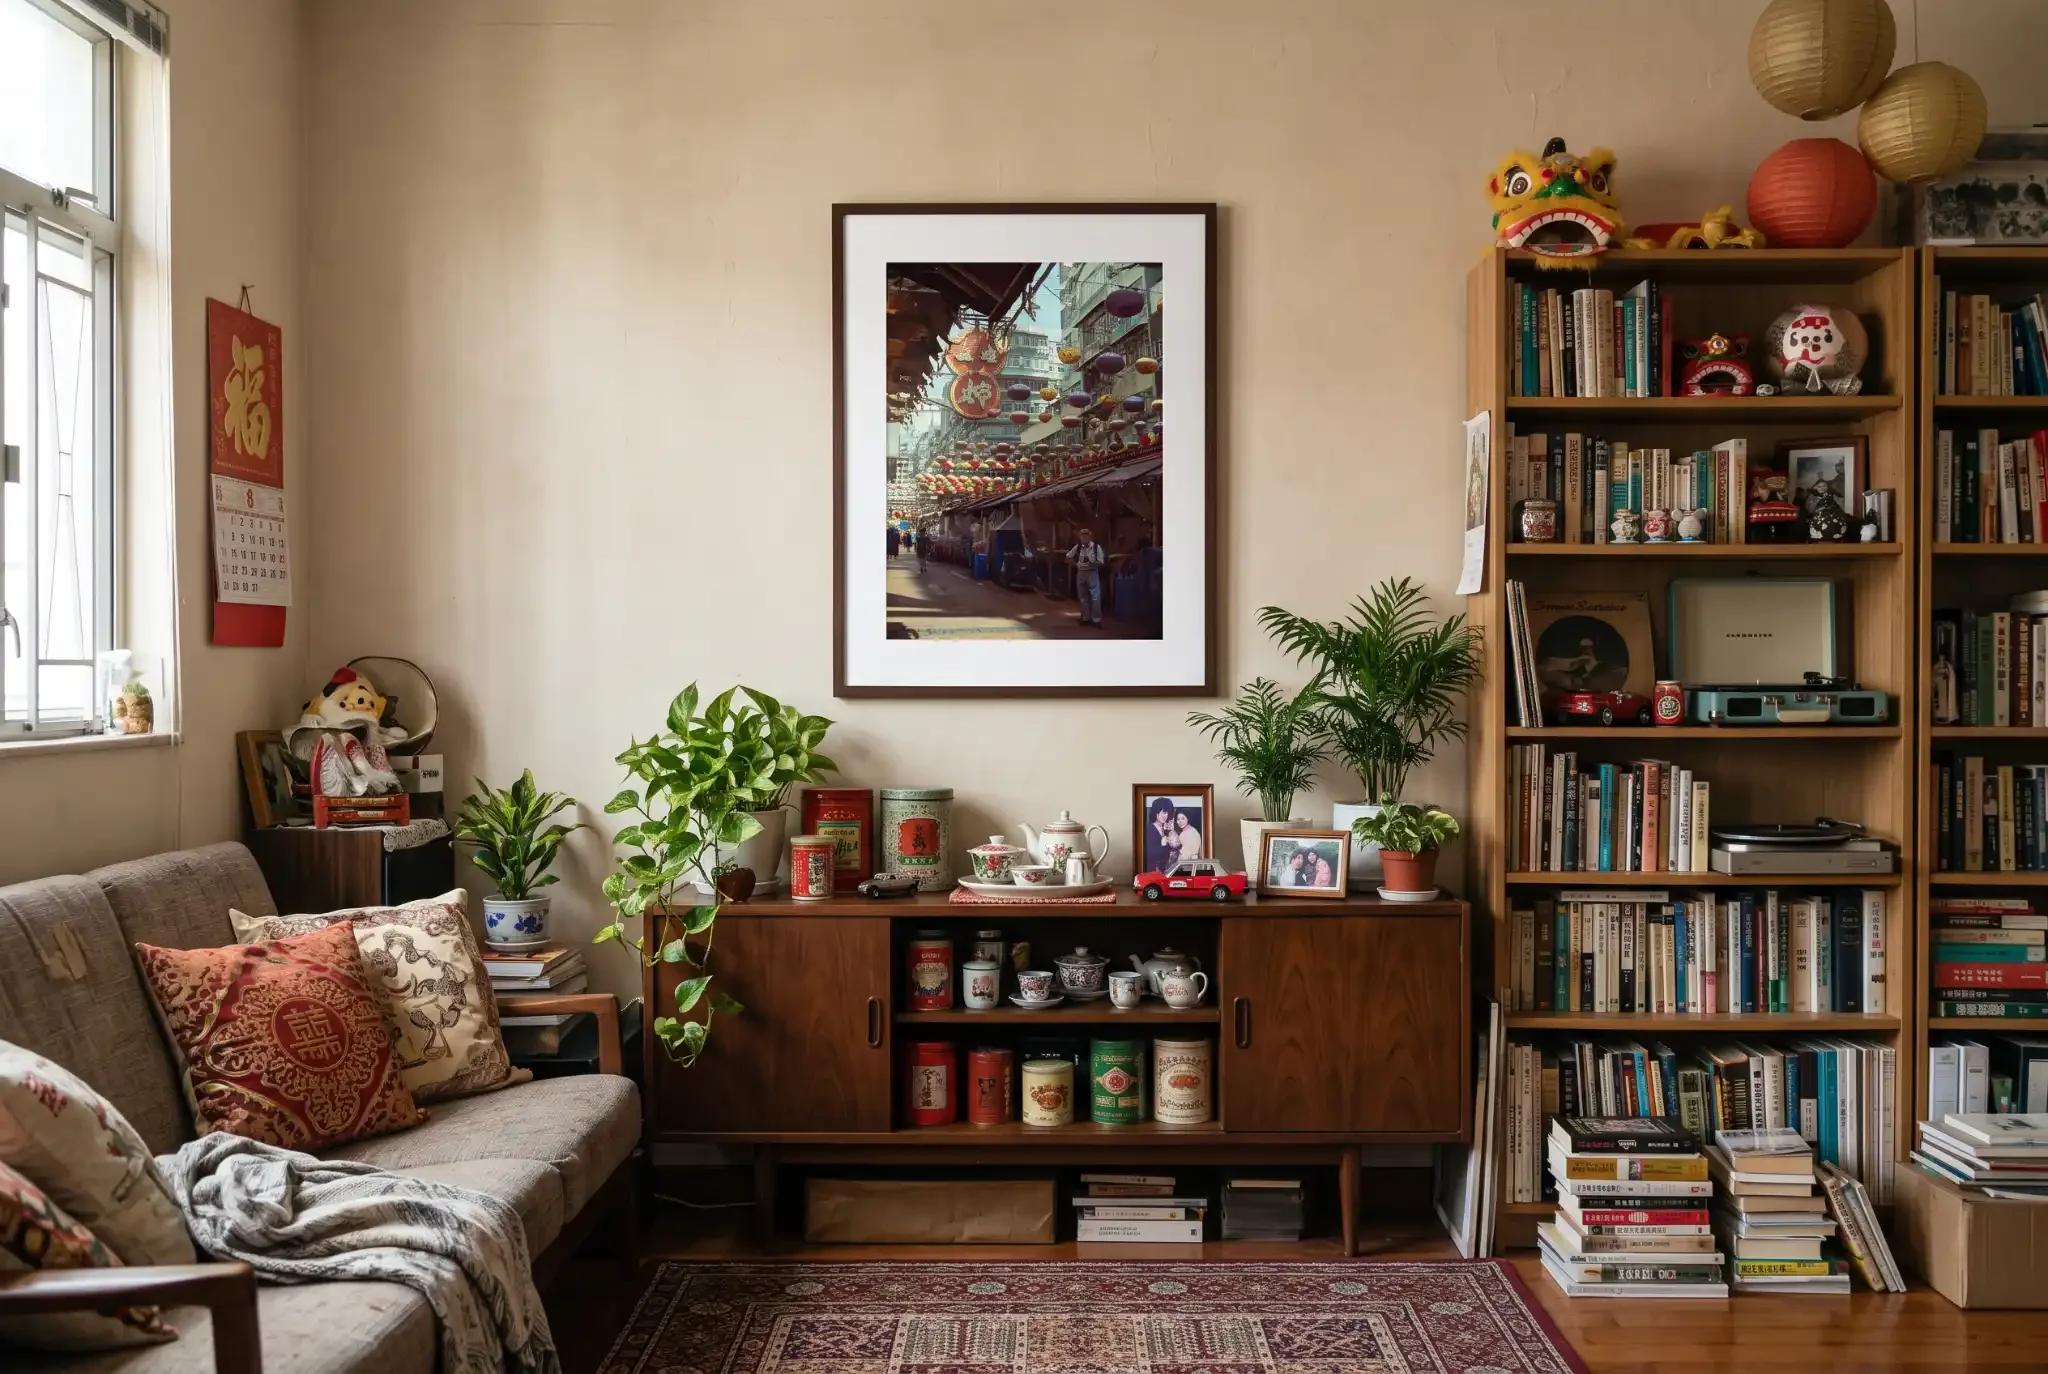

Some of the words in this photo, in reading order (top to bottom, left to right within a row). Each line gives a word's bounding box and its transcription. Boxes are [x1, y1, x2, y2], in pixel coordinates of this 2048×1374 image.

[247, 489, 254, 508] 8
[240, 517, 245, 527] 2
[240, 533, 245, 543] 9
